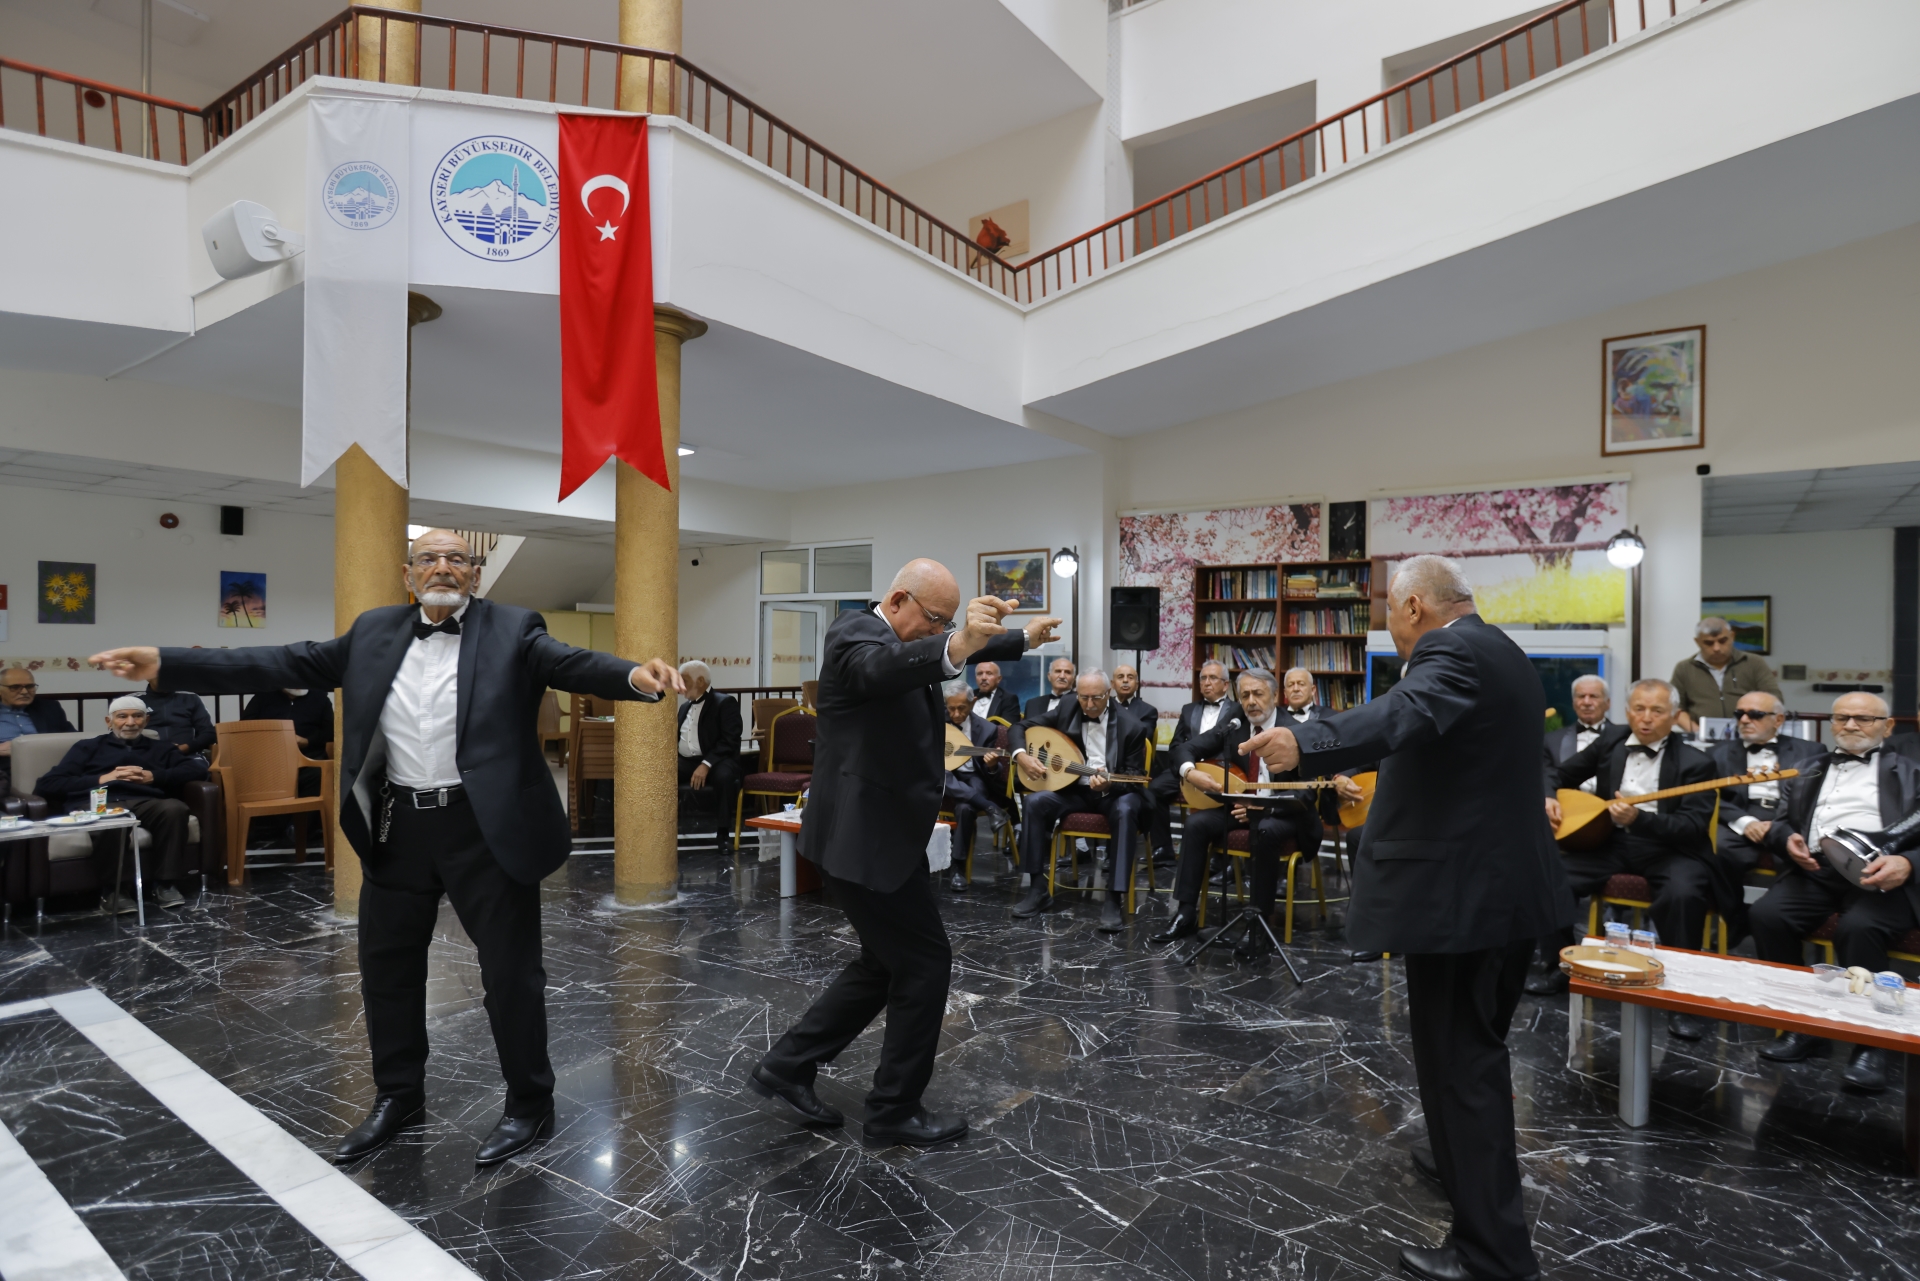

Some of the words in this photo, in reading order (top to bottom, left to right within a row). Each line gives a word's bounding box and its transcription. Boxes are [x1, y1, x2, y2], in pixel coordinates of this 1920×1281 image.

[327, 179, 337, 210] KAYSERİ
[334, 164, 379, 180] BÜYÜKŞEHİR
[379, 173, 396, 214] BELEDİYESİ
[436, 167, 453, 223] KAYSERİ
[448, 141, 532, 169] BÜYÜKŞEHİR
[486, 247, 510, 257] 1869
